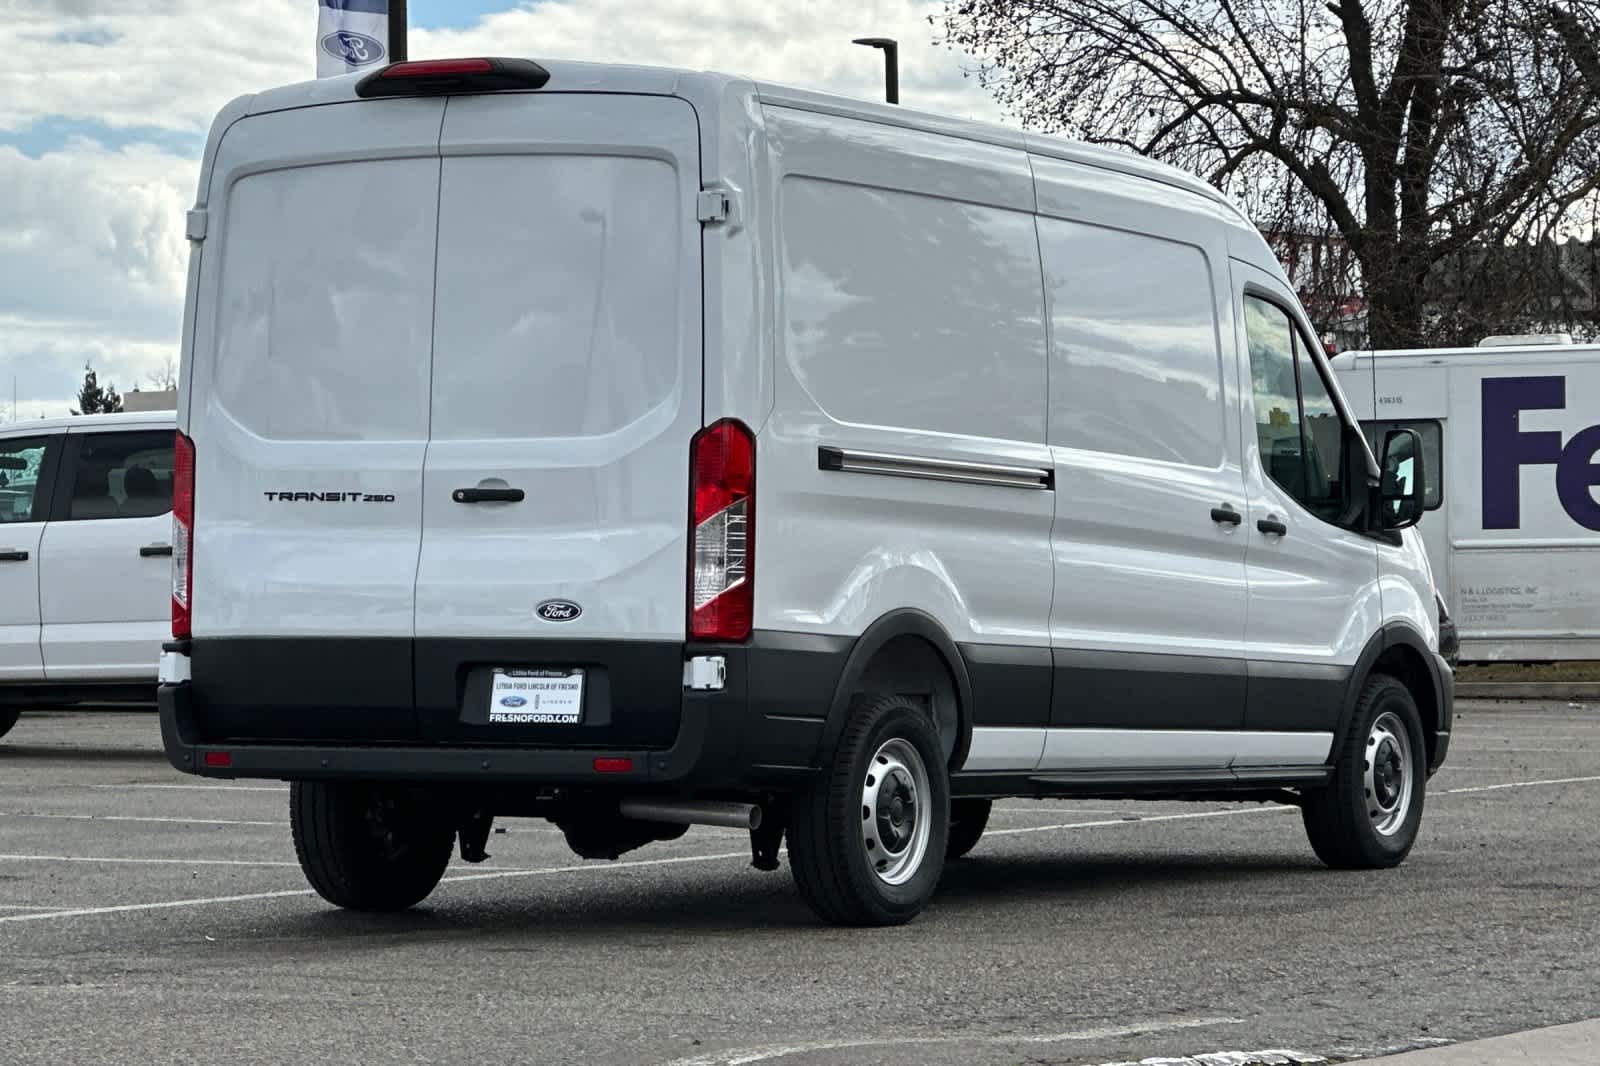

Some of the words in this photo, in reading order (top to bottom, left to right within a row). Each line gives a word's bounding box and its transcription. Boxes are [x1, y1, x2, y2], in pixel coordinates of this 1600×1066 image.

[263, 491, 362, 502] TRANSIT
[362, 494, 396, 502] 250
[528, 682, 550, 690] LINCOLN
[489, 714, 578, 723] FRESNOFORD.COM
